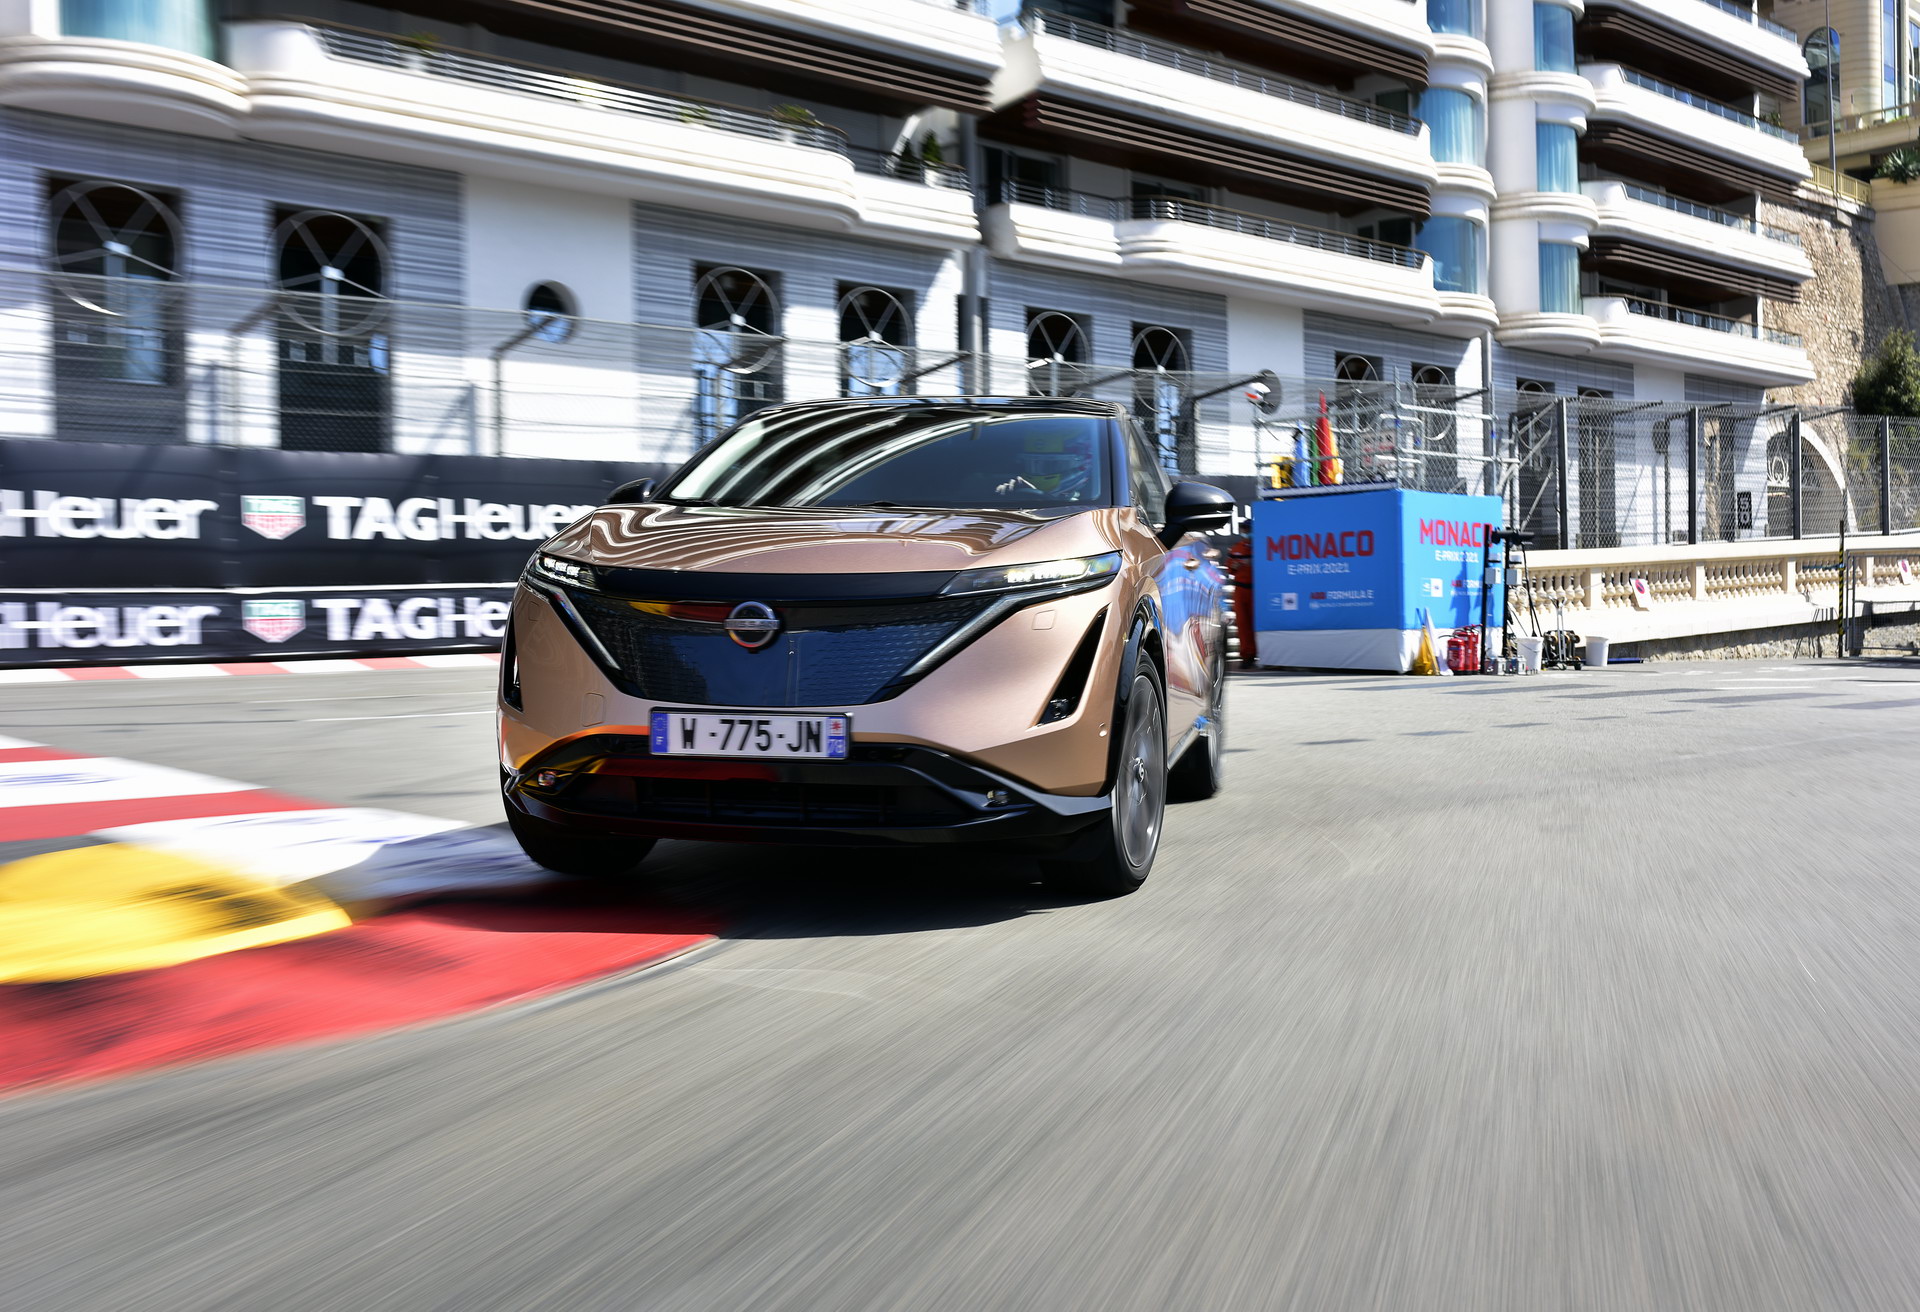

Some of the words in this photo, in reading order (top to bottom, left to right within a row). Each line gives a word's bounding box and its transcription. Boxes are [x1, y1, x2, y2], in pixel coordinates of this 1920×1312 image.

[1266, 530, 1374, 561] MONACO
[1287, 564, 1321, 575] E-PRIX
[1322, 562, 1350, 574] 2021
[1327, 590, 1366, 600] FORMULA
